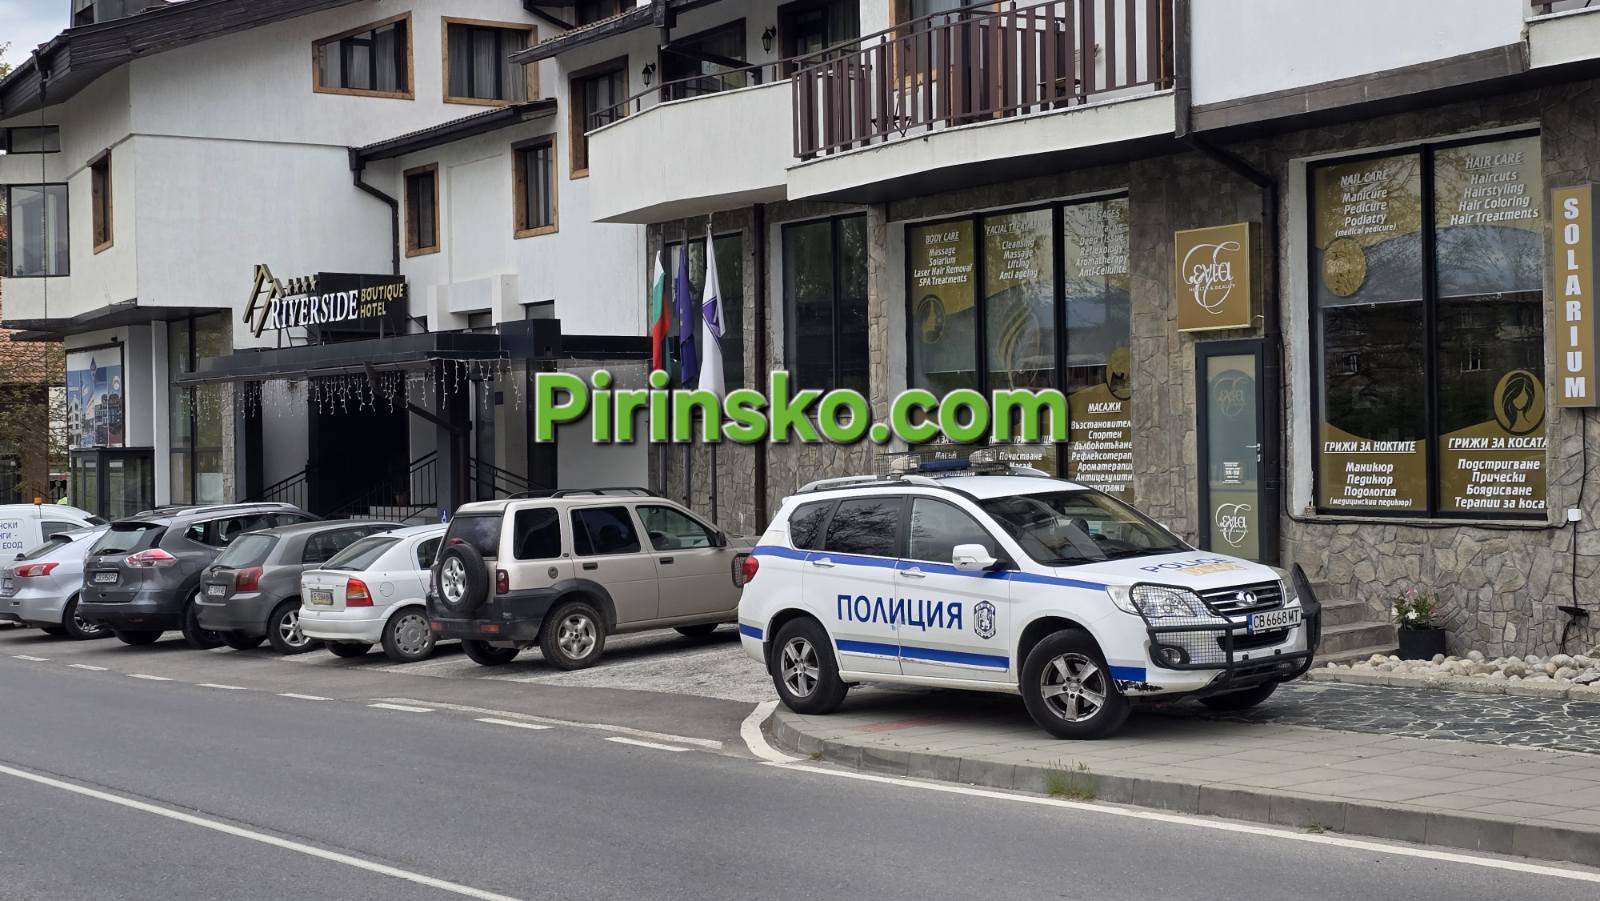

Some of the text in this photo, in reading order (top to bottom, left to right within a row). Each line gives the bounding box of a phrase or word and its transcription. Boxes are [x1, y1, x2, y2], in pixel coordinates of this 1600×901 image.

[1466, 151, 1522, 169] HAIR CARE
[1341, 169, 1390, 187] NAIL CARE
[1470, 171, 1517, 185] Haircuts
[1342, 189, 1388, 203] Manicure
[1463, 183, 1525, 199] Hairstyling
[1344, 201, 1387, 215] Pedicure
[1458, 195, 1530, 212] Hair Coloring
[1345, 214, 1387, 227] Podiatry
[1450, 208, 1539, 226] Hair Treatments
[986, 223, 1008, 236] FACIAL
[1335, 223, 1397, 238] (medical pedicure)
[926, 231, 960, 244] BODY CARE
[1002, 239, 1035, 250] Cleansing
[929, 247, 956, 257] Massage
[1003, 248, 1034, 260] Massage
[929, 256, 956, 267] Solarium
[1008, 258, 1030, 269] Lifting
[1075, 254, 1129, 267] Aromatherapy
[914, 263, 973, 278] Laser Hair Removal
[1000, 268, 1038, 280] Anti ageing
[1079, 264, 1127, 277] Anti-Cellulite
[919, 274, 968, 287] SPA Treatments
[1563, 197, 1586, 398] SOLARIUM
[269, 283, 404, 330] RIVERSIDE BOUTIQUE
[360, 302, 387, 319] HOTEL
[1088, 402, 1122, 412] МАСАЖИ
[1088, 430, 1122, 440] Спортен
[1324, 441, 1416, 452] ГРИЖИ ЗА НОКТИТЕ
[1448, 438, 1488, 449] ГРИЖИ
[1491, 438, 1505, 449] ЗА
[1000, 451, 1042, 461] Почистване
[1346, 462, 1393, 474] Маникюр
[1458, 459, 1540, 471] Подстригване
[1347, 474, 1393, 486] Педикюр
[1472, 472, 1526, 484] Прически
[1344, 486, 1397, 498] Подология
[1466, 484, 1532, 496] Боядисване
[1378, 498, 1412, 507] педикюр)
[1455, 497, 1545, 509] Терапии за коса
[2, 541, 23, 549] ЕООД
[1140, 558, 1234, 573] POLICE
[837, 594, 963, 632] ПОЛИЦИЯ
[1253, 614, 1265, 628] CB
[1266, 611, 1287, 626] 6668
